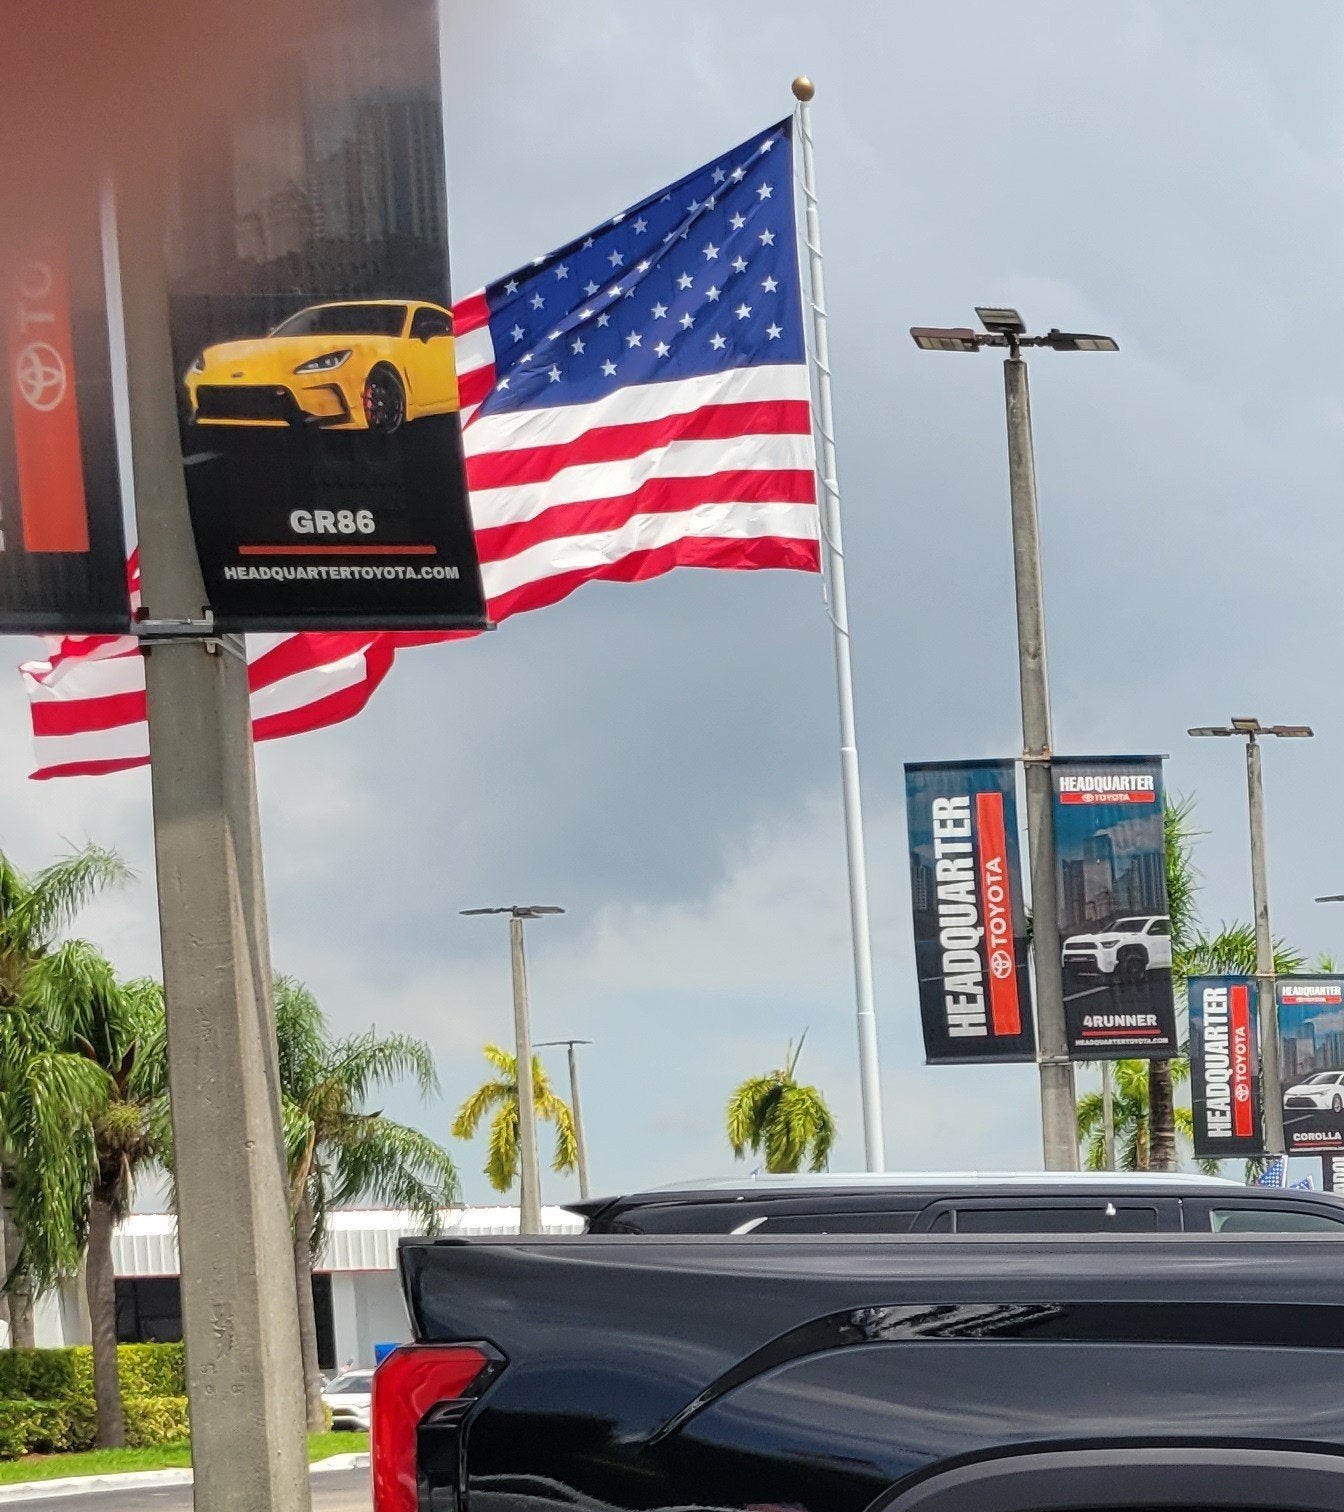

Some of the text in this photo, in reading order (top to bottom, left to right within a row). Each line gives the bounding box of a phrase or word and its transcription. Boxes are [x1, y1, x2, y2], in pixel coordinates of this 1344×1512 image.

[290, 510, 376, 535] GR86
[224, 566, 460, 581] HEADQUARTERTOYOTA.COM
[1060, 775, 1154, 793] HEADQUARTER
[985, 856, 1009, 949] TOYOTA
[932, 795, 988, 1037] HEADQUARTER
[1083, 1014, 1158, 1028] 4RUNNER
[1202, 987, 1233, 1138] HEADQUARTER
[1235, 1026, 1247, 1083] TOYOTA
[1292, 1131, 1342, 1141] COROLLA
